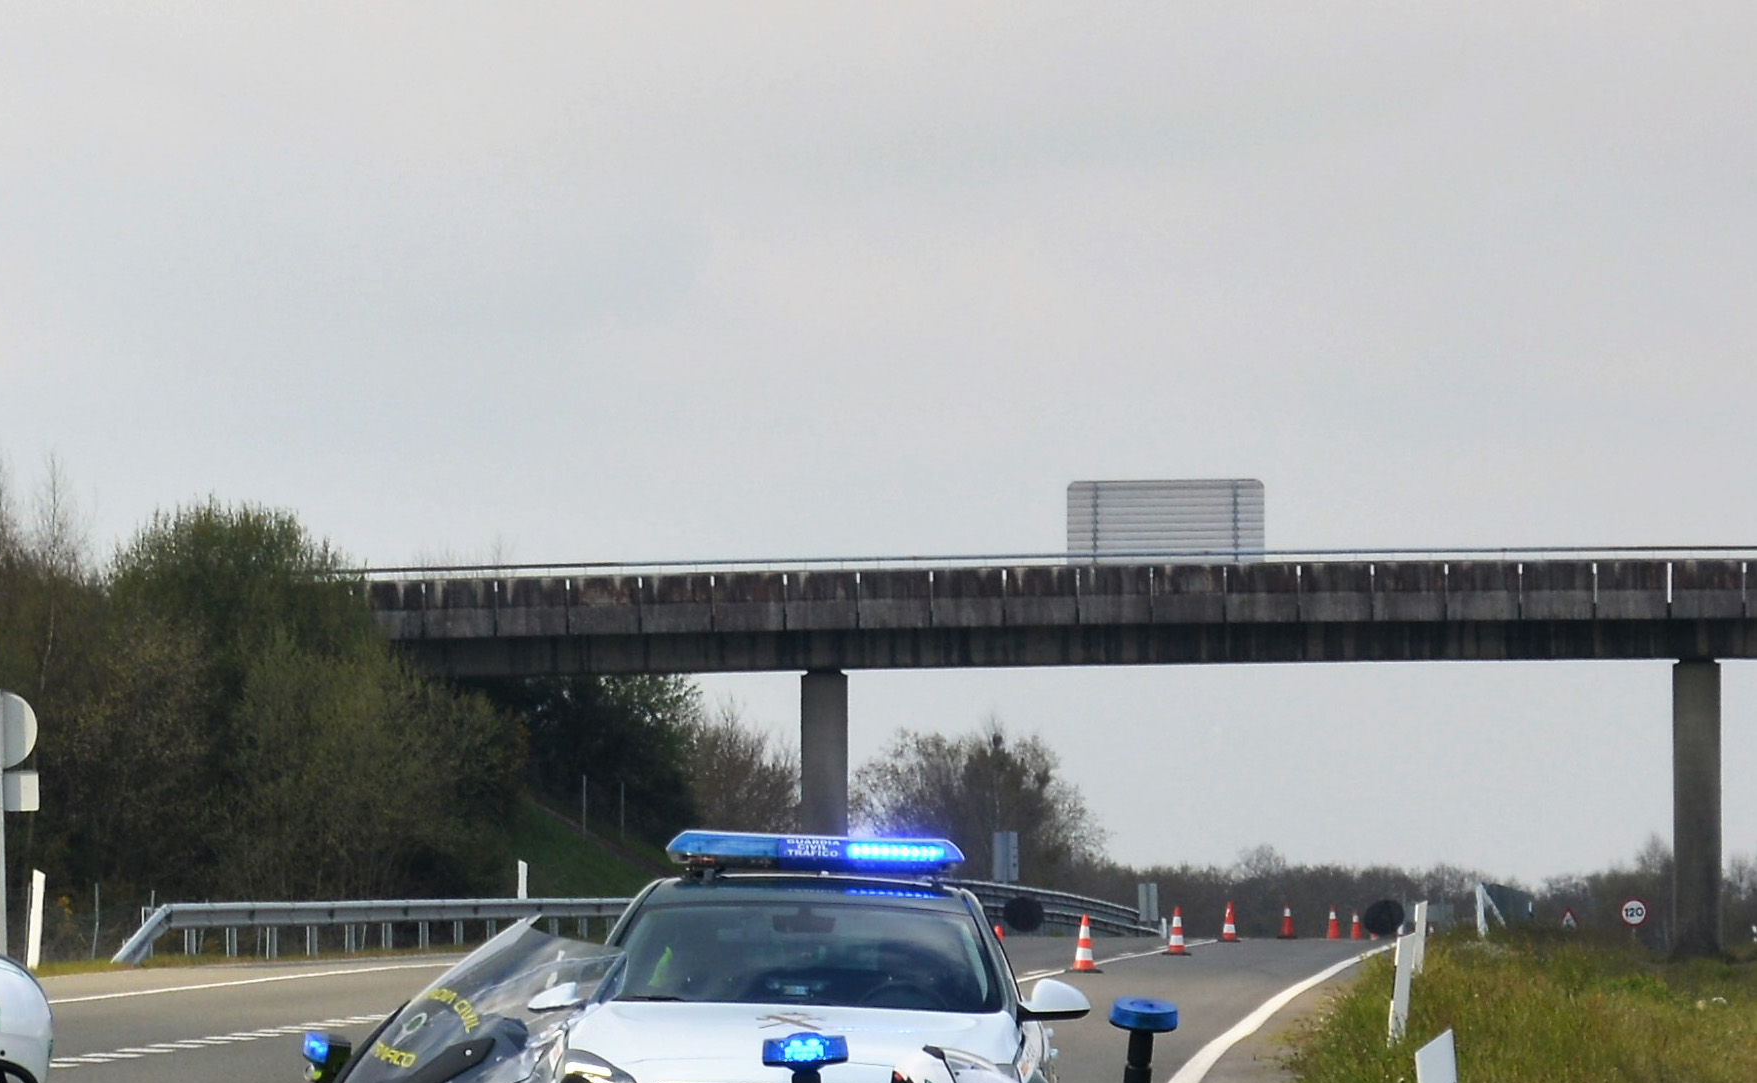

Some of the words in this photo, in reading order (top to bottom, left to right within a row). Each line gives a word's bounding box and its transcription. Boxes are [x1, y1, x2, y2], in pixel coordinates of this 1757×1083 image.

[786, 838, 841, 846] GUARDIA
[787, 849, 839, 857] TRAFICO
[1624, 907, 1644, 917] 120
